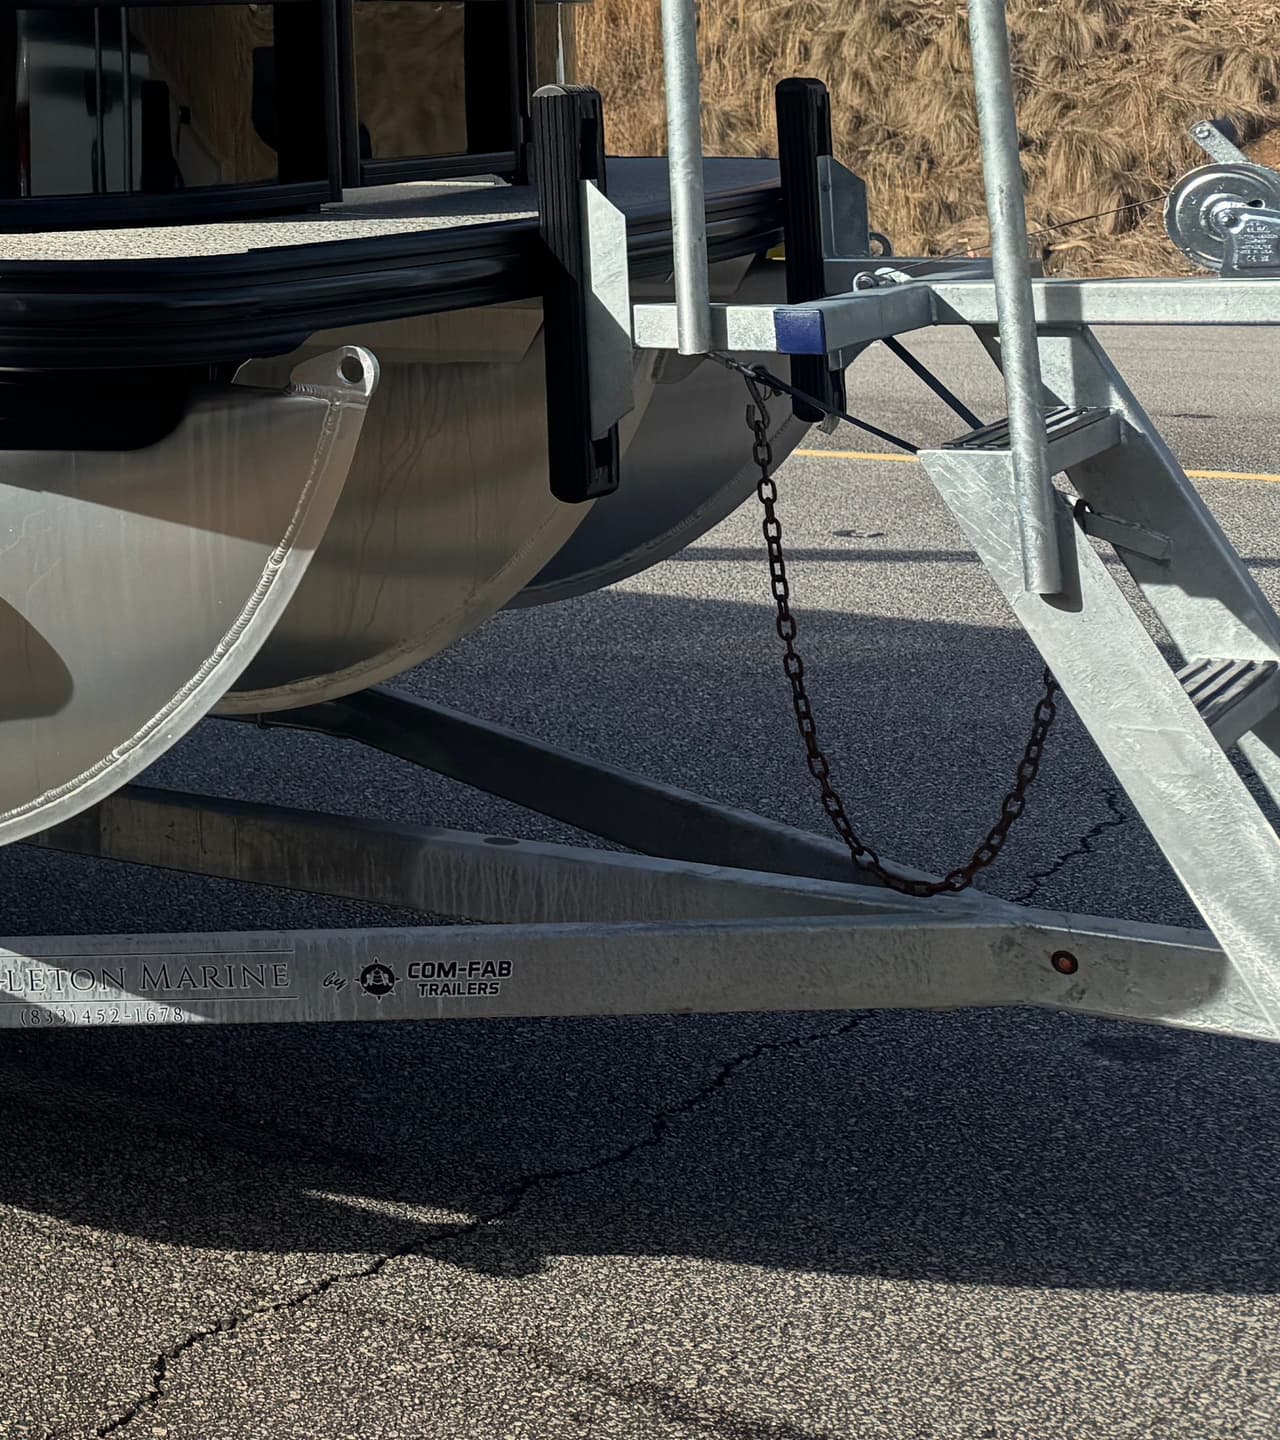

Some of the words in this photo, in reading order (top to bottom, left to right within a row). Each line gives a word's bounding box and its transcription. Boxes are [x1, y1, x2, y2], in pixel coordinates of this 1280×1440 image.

[140, 962, 291, 992] MARINE
[407, 960, 513, 979] COM-FAB
[322, 971, 347, 992] by
[418, 981, 500, 998] TRAILERS
[19, 1006, 185, 1027] (833)452-1678
